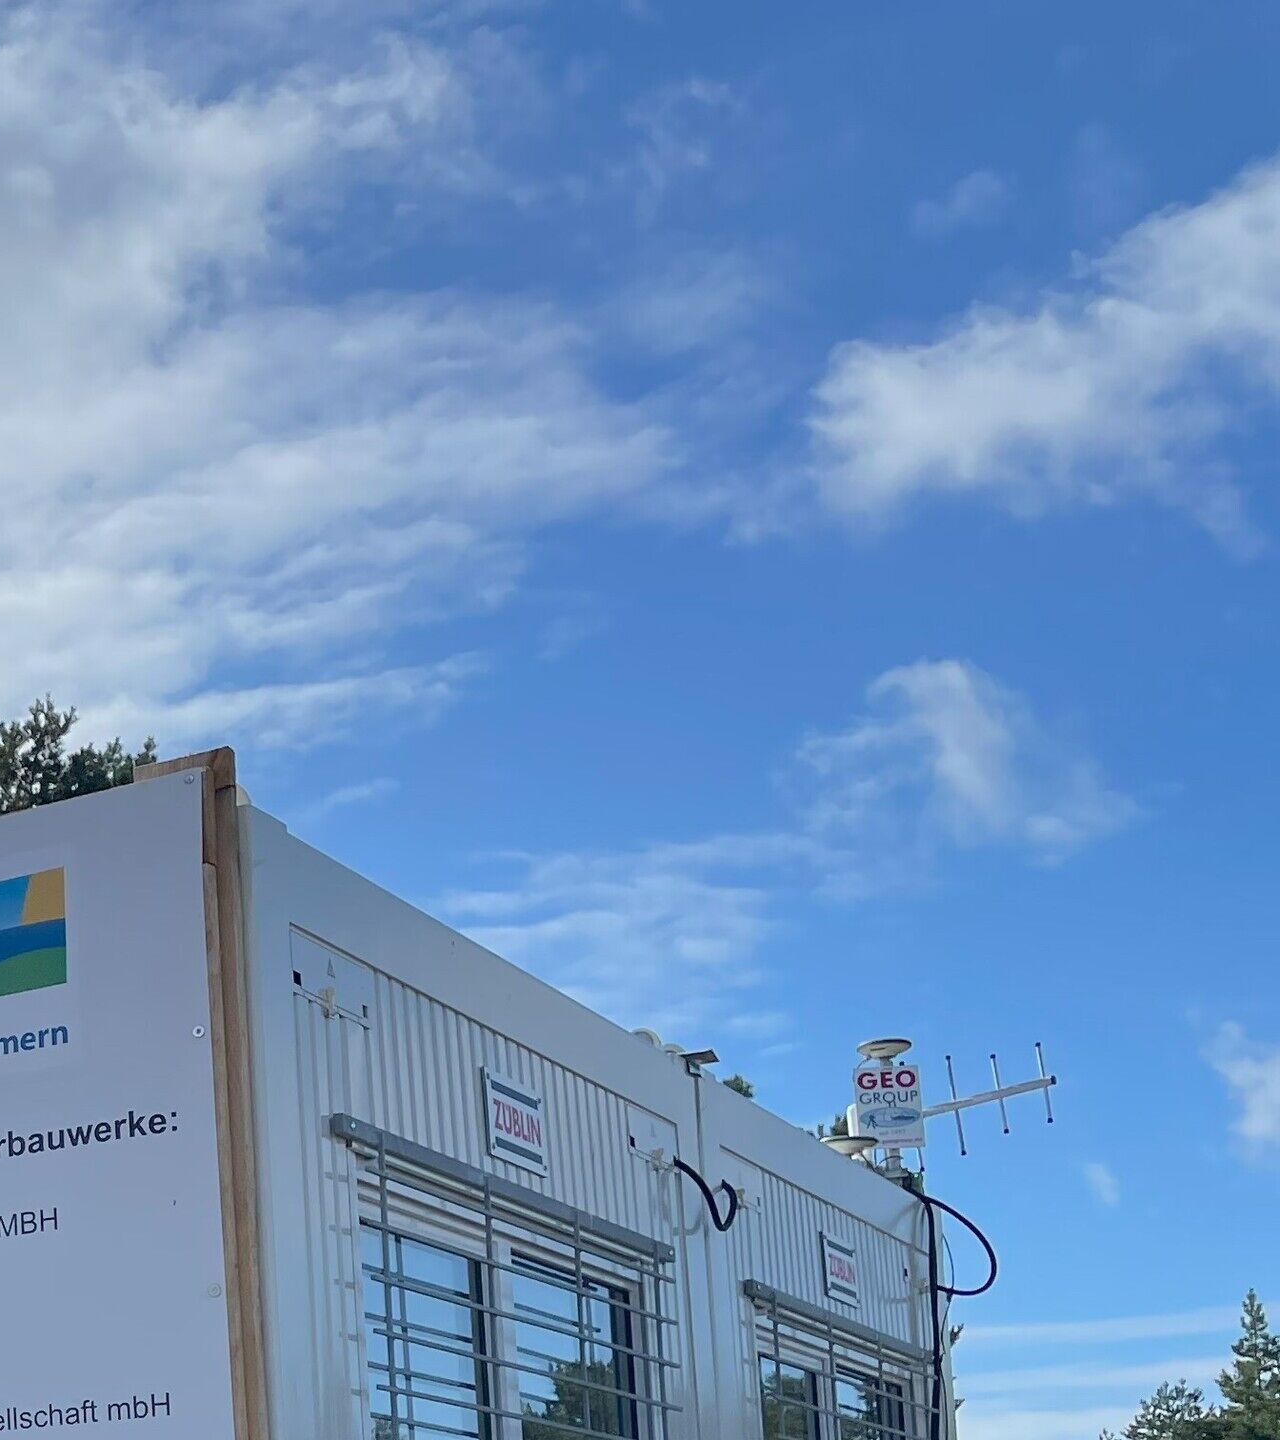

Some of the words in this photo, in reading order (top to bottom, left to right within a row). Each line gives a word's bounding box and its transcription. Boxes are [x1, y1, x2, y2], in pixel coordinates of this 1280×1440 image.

[856, 1069, 917, 1090] GEO
[859, 1090, 919, 1107] GROUP
[107, 1391, 171, 1421] mbH
